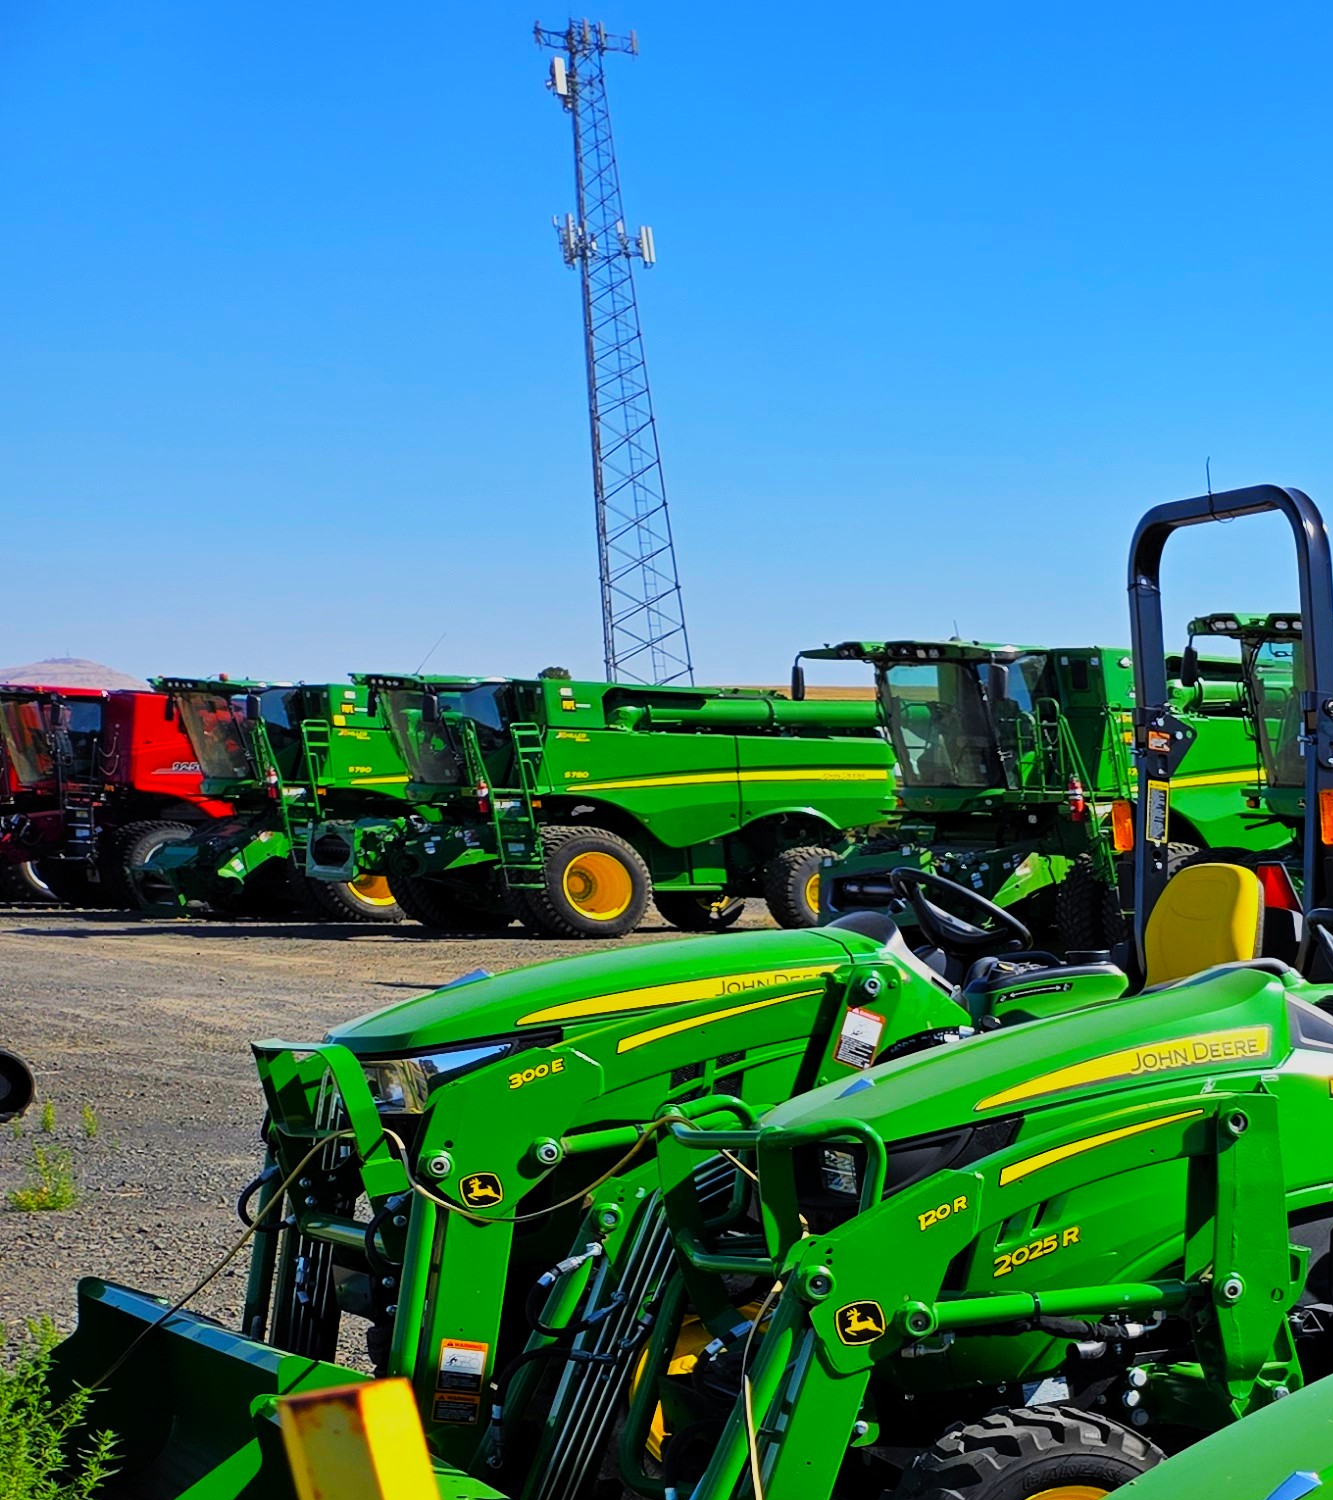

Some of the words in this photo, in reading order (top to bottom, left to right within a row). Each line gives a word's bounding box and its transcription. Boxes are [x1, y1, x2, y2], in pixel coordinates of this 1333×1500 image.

[508, 1063, 549, 1090] 300
[551, 1057, 564, 1074] E
[1131, 1047, 1189, 1073] JOHN
[1193, 1038, 1261, 1062] DEERE
[917, 1203, 952, 1232] 120
[953, 1195, 968, 1213] R
[993, 1233, 1058, 1278] 2025
[1062, 1226, 1080, 1248] R
